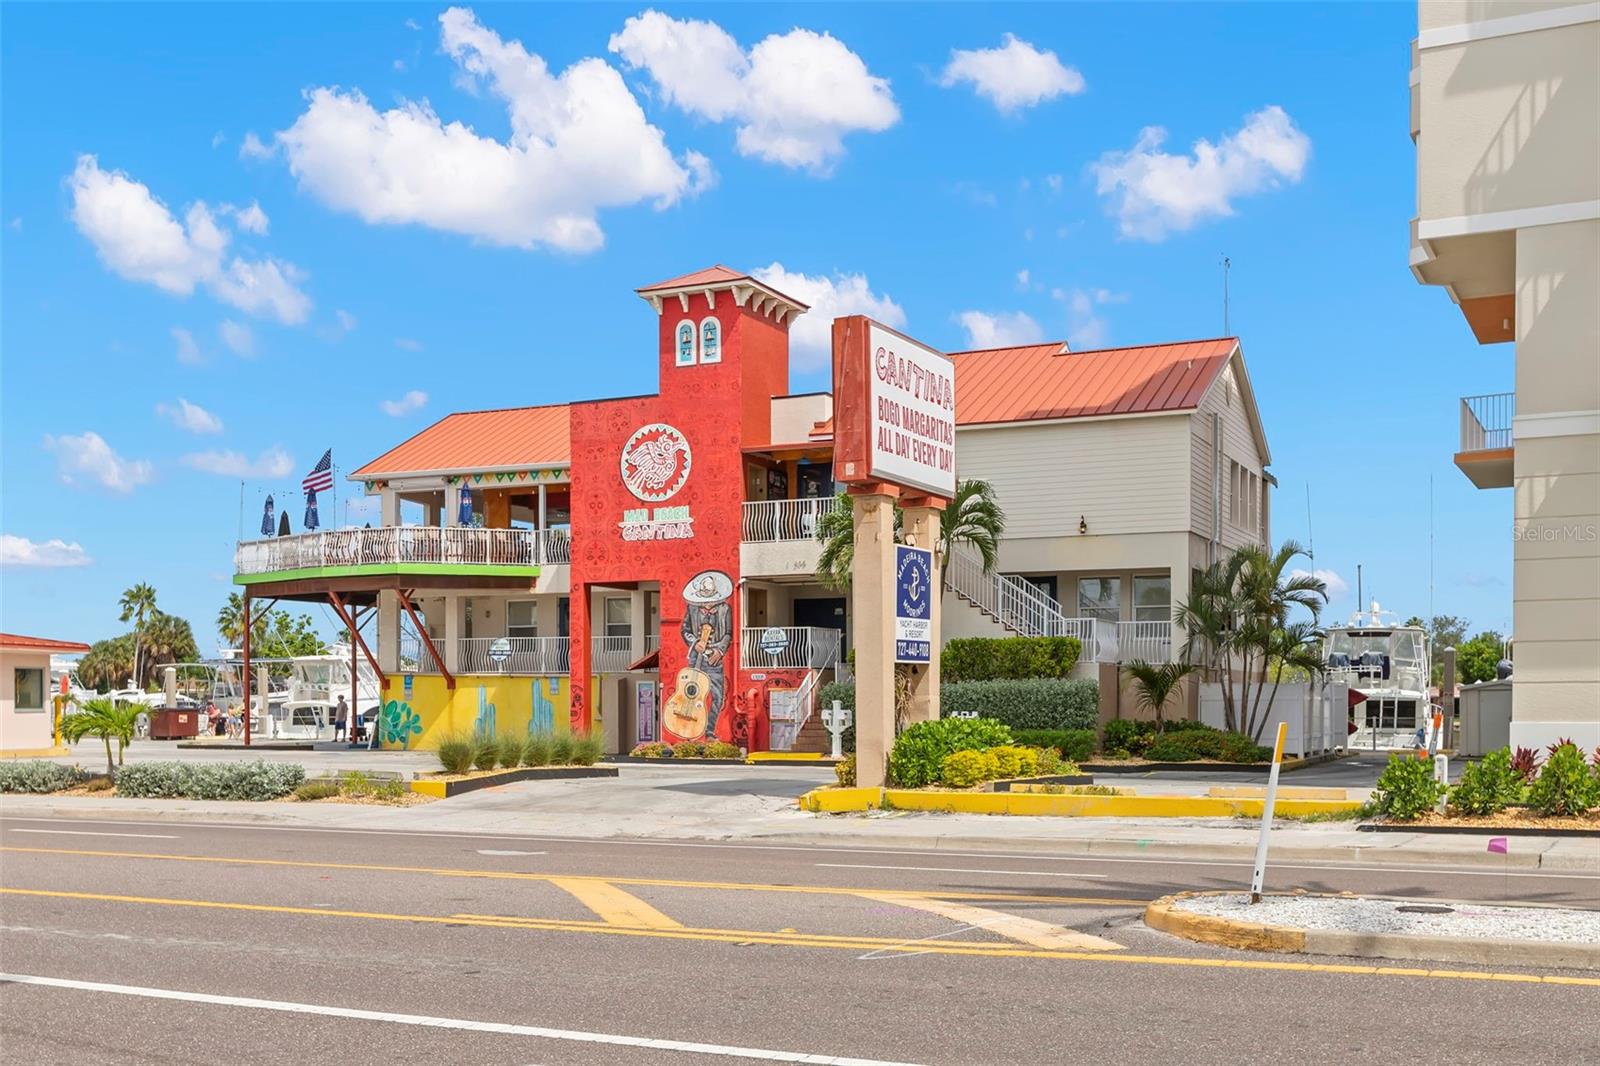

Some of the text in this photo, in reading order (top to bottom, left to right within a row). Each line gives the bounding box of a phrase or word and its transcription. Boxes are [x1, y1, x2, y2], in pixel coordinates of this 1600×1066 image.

[875, 346, 954, 410] CANTINA
[877, 395, 953, 446] BOGO MARGARITAS
[877, 426, 953, 473] ALL DAY EVERY DAY
[622, 523, 694, 541] CANTINA
[897, 551, 931, 584] MADEIRA BEACH
[902, 599, 926, 617] MOORINGS
